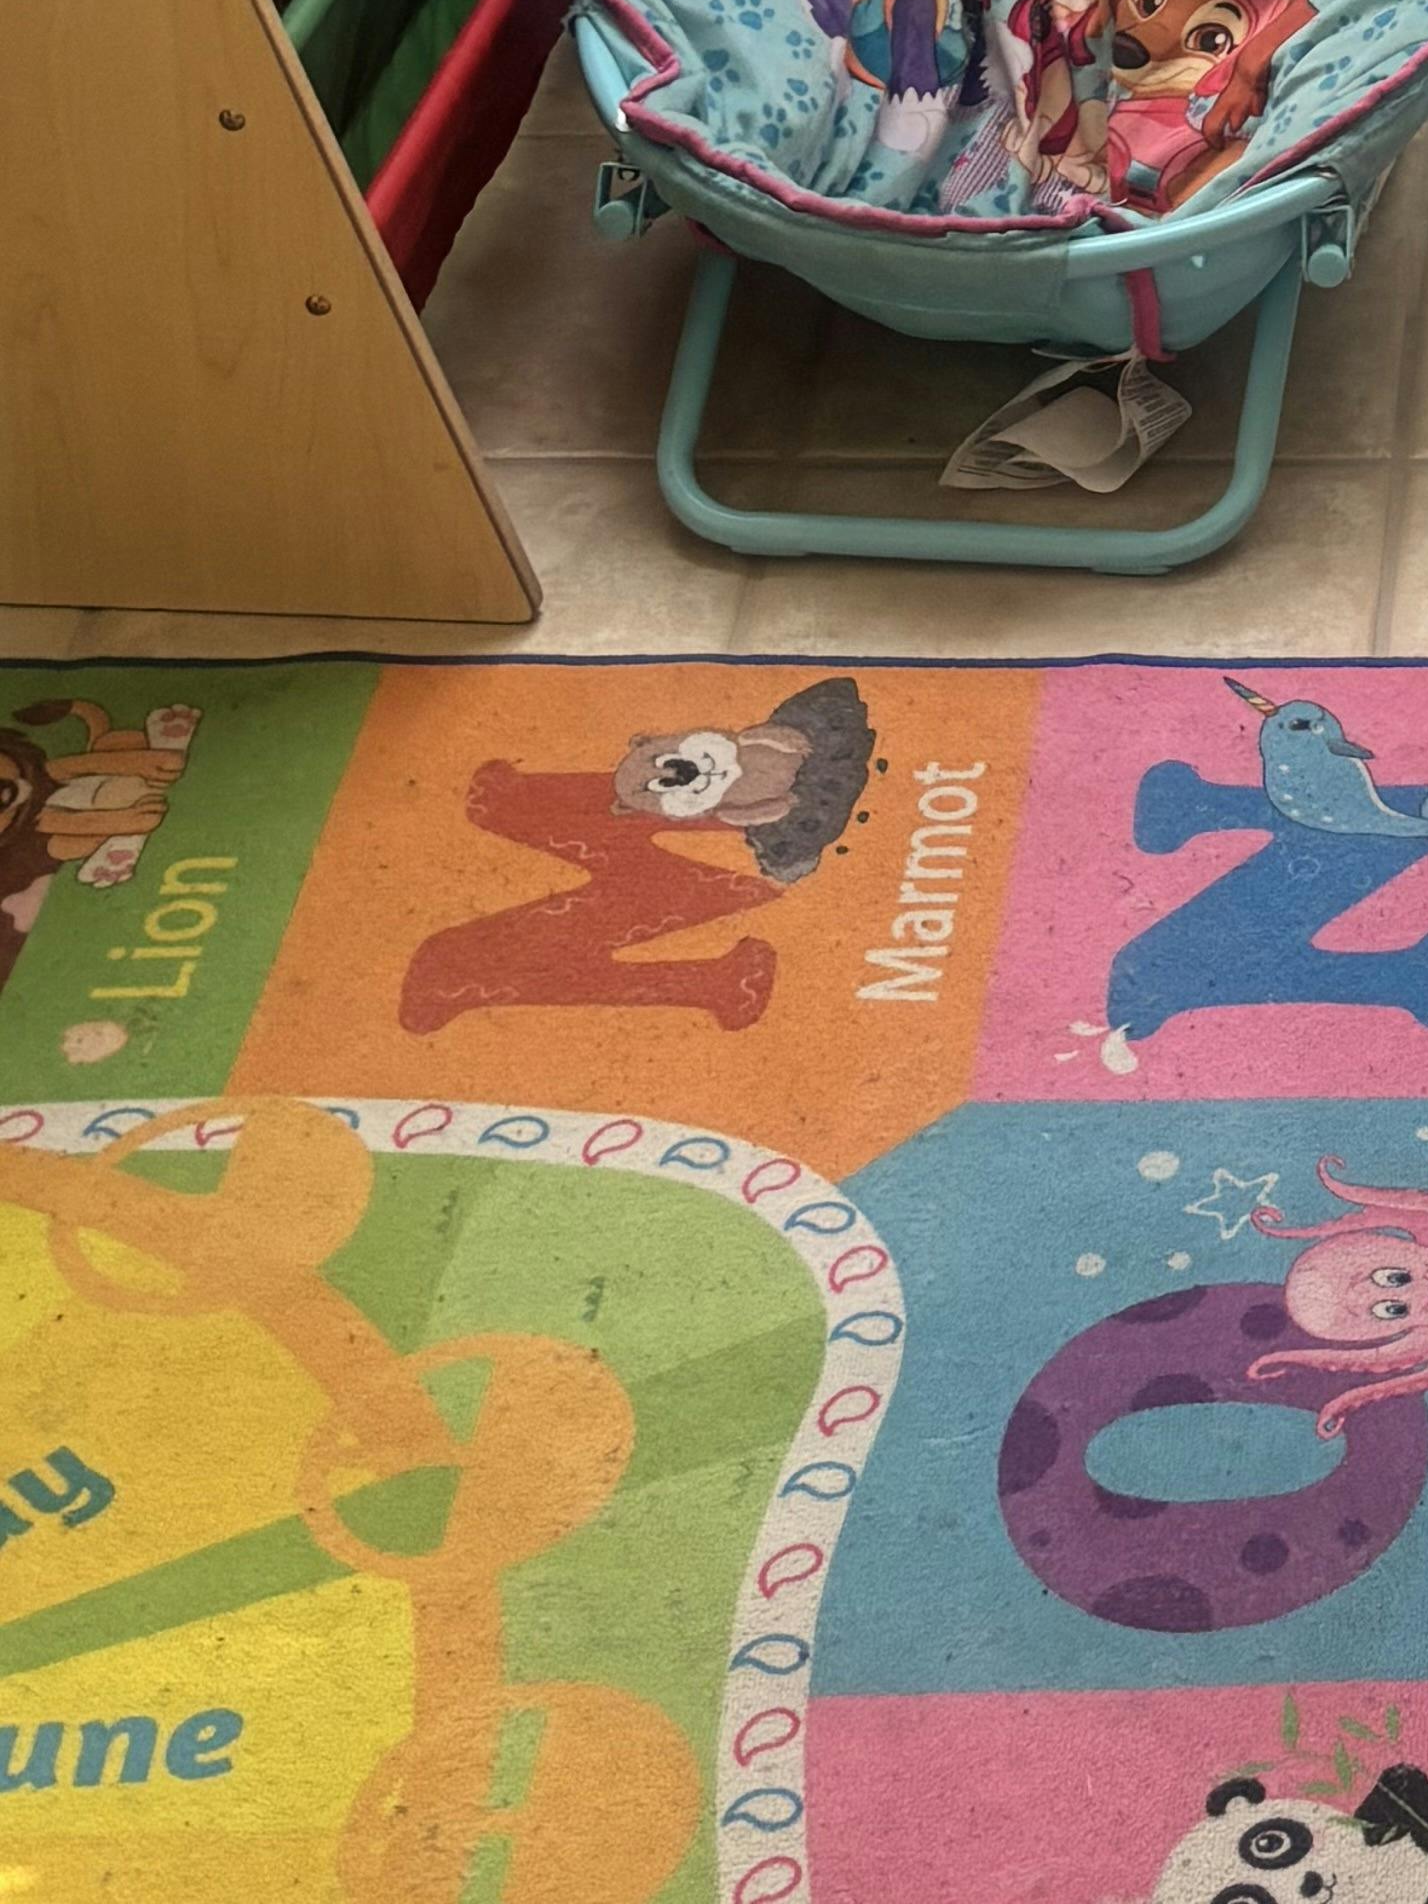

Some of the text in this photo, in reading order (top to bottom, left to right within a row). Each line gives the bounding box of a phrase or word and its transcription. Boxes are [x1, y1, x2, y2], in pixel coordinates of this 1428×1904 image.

[89, 856, 239, 999] Lion
[400, 757, 783, 1035] M
[856, 761, 986, 1005] Marmot
